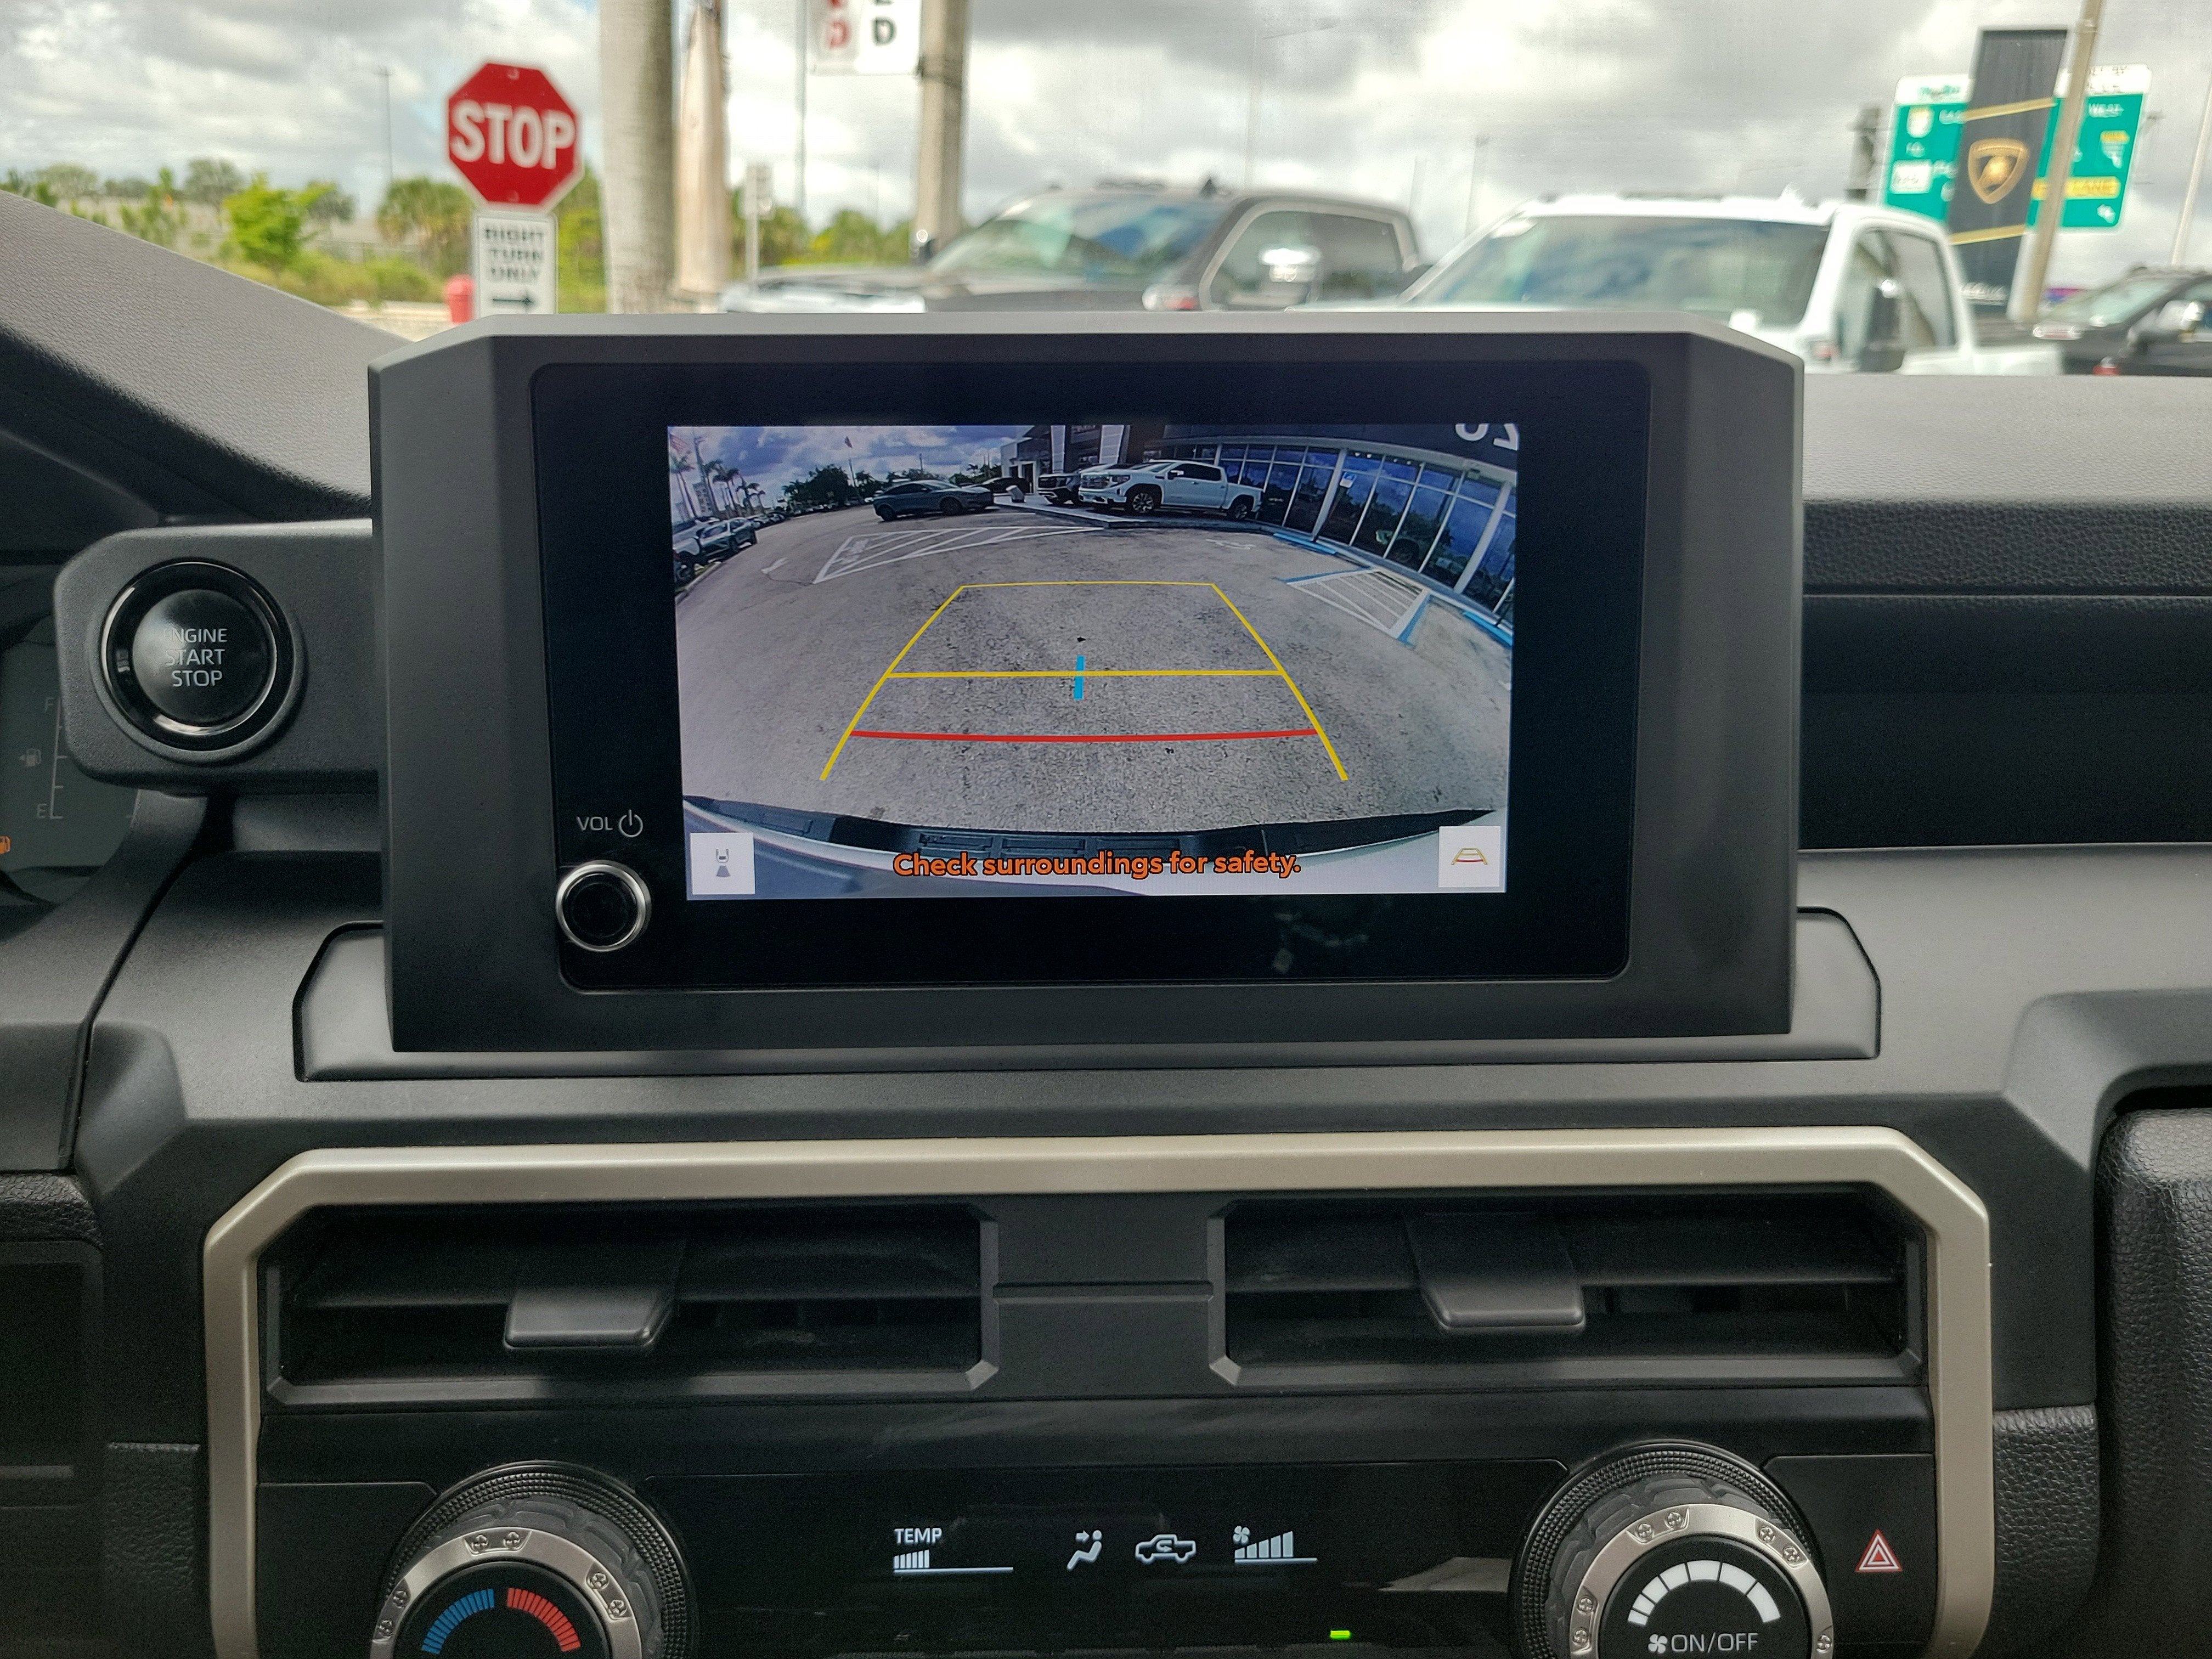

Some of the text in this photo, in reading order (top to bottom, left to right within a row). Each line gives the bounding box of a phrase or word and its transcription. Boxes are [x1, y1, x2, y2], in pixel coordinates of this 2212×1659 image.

[450, 99, 577, 170] STOP
[165, 648, 225, 666] START
[171, 670, 223, 687] STOP
[37, 803, 47, 819] E
[576, 816, 613, 831] VOL
[894, 850, 1301, 879] Check surroundings for safety.
[894, 1528, 943, 1544] TEMP
[1671, 1632, 1758, 1654] ON/OFF
